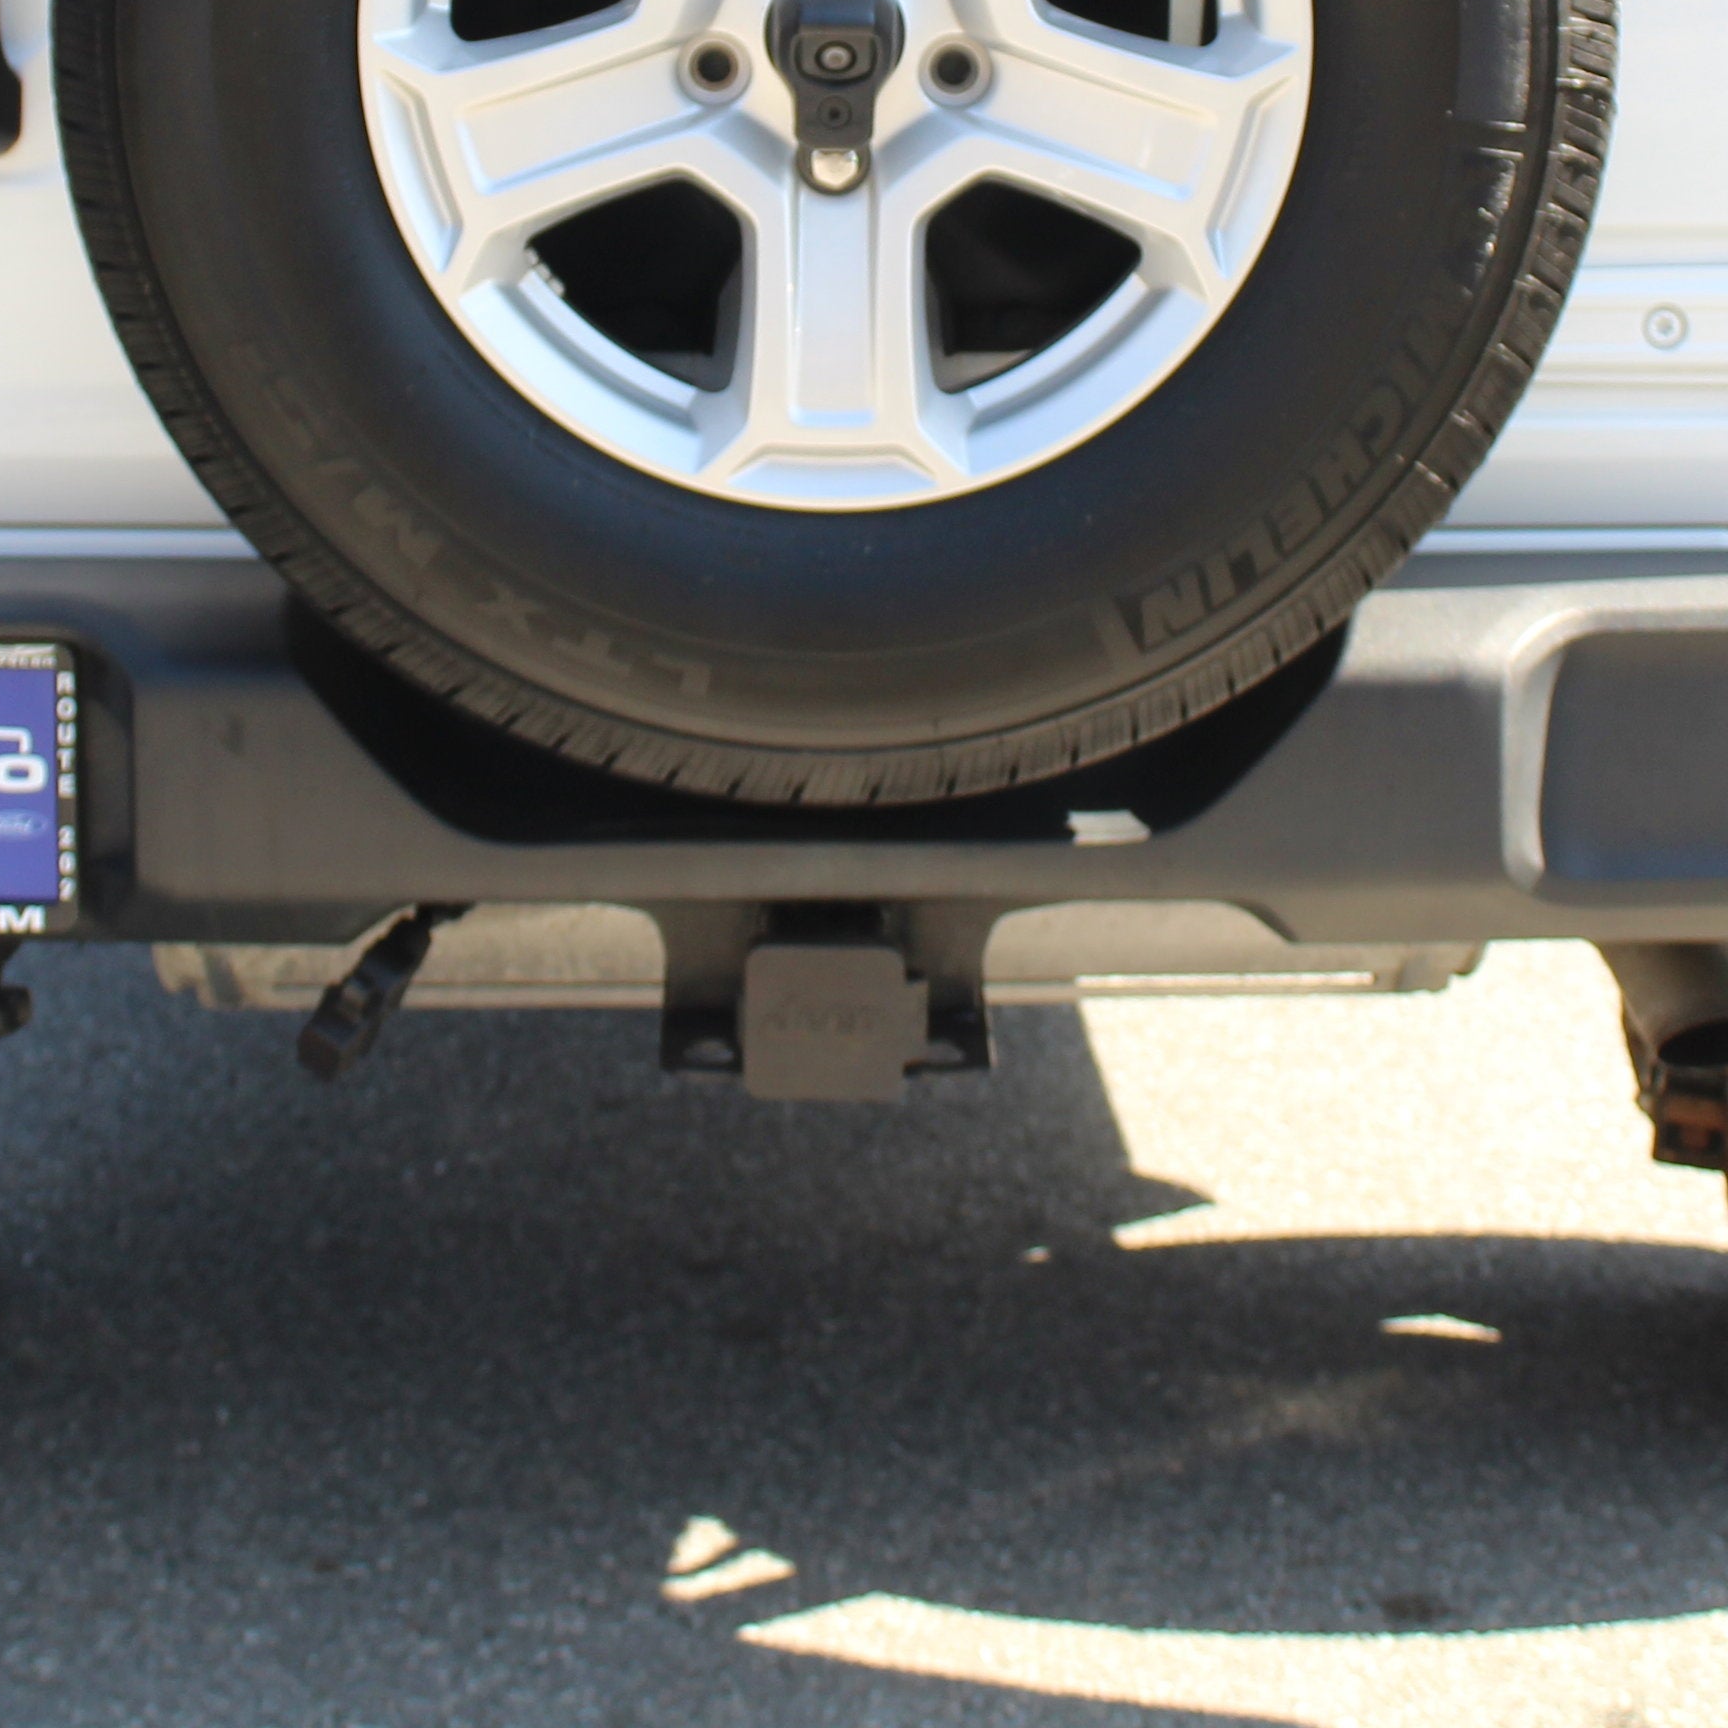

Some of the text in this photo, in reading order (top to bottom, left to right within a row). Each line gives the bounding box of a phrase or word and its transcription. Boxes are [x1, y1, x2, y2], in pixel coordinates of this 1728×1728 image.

[1119, 271, 1477, 653] MICHELIN
[469, 571, 715, 700] LTX
[56, 671, 77, 902] ROUTE 202
